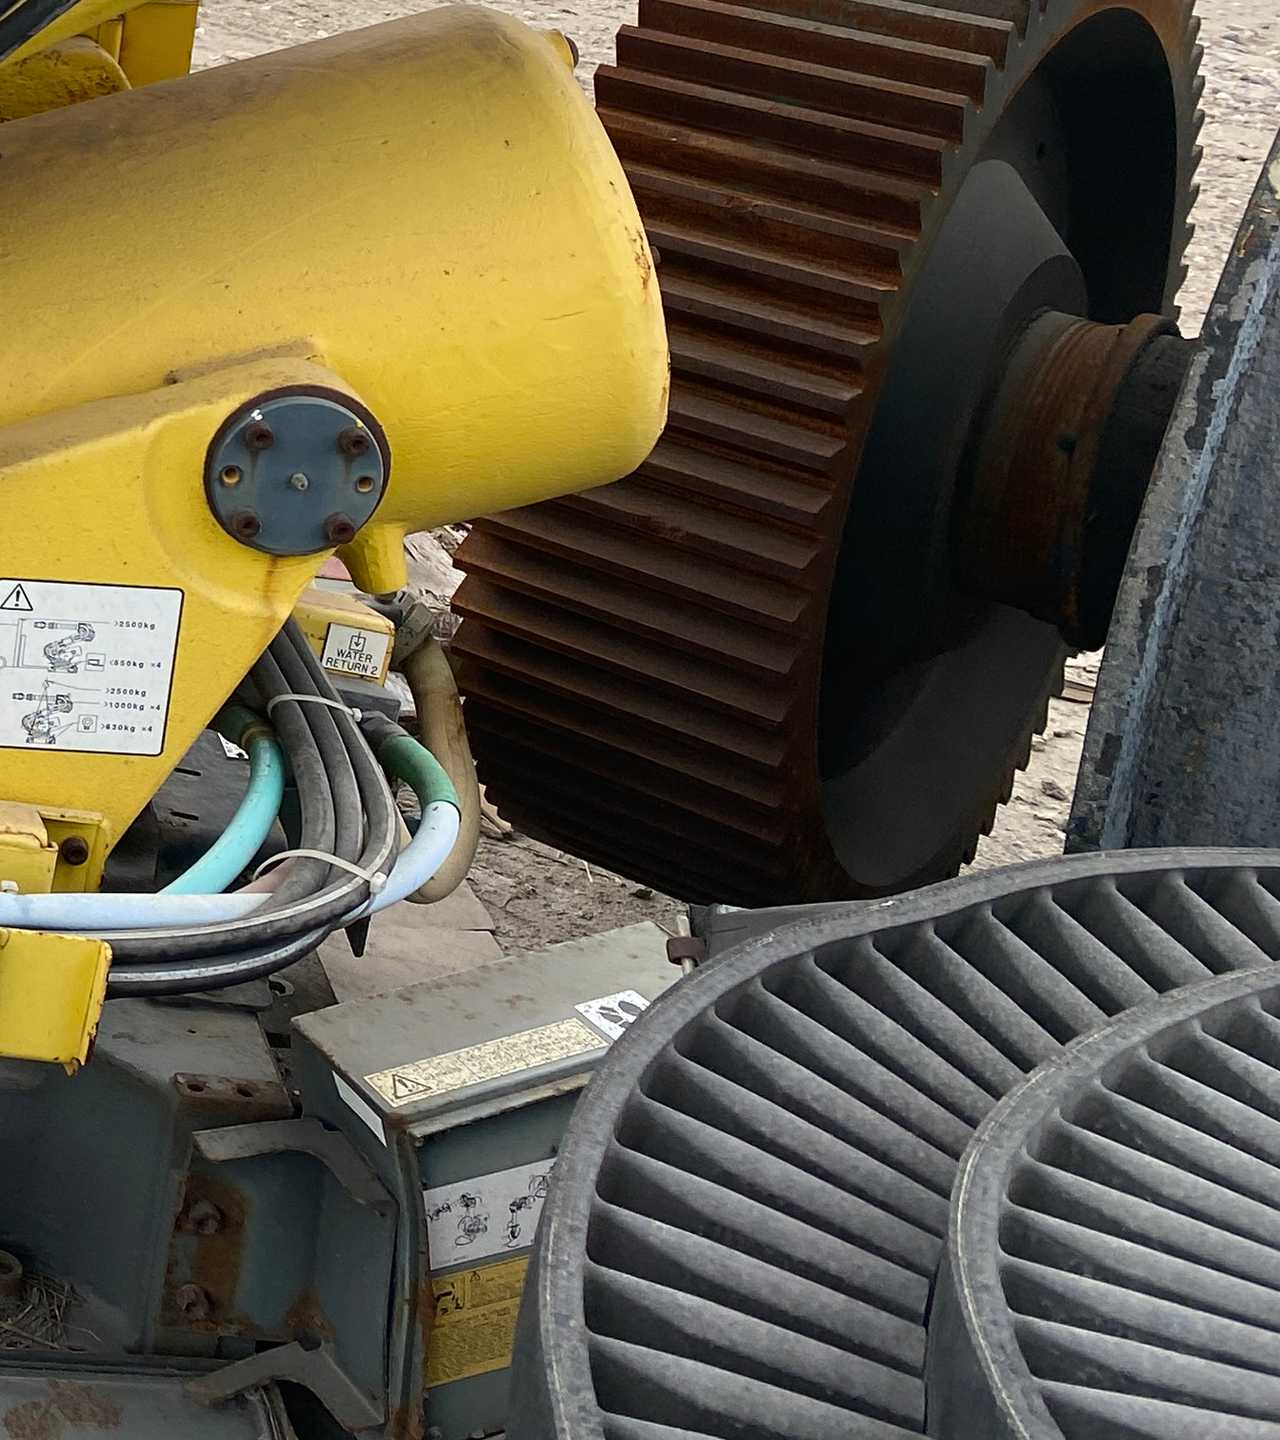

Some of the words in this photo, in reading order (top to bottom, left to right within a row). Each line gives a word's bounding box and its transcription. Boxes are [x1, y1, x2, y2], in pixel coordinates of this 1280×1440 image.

[337, 648, 373, 663] WATER
[325, 657, 369, 674] RETURN
[370, 665, 378, 675] 2
